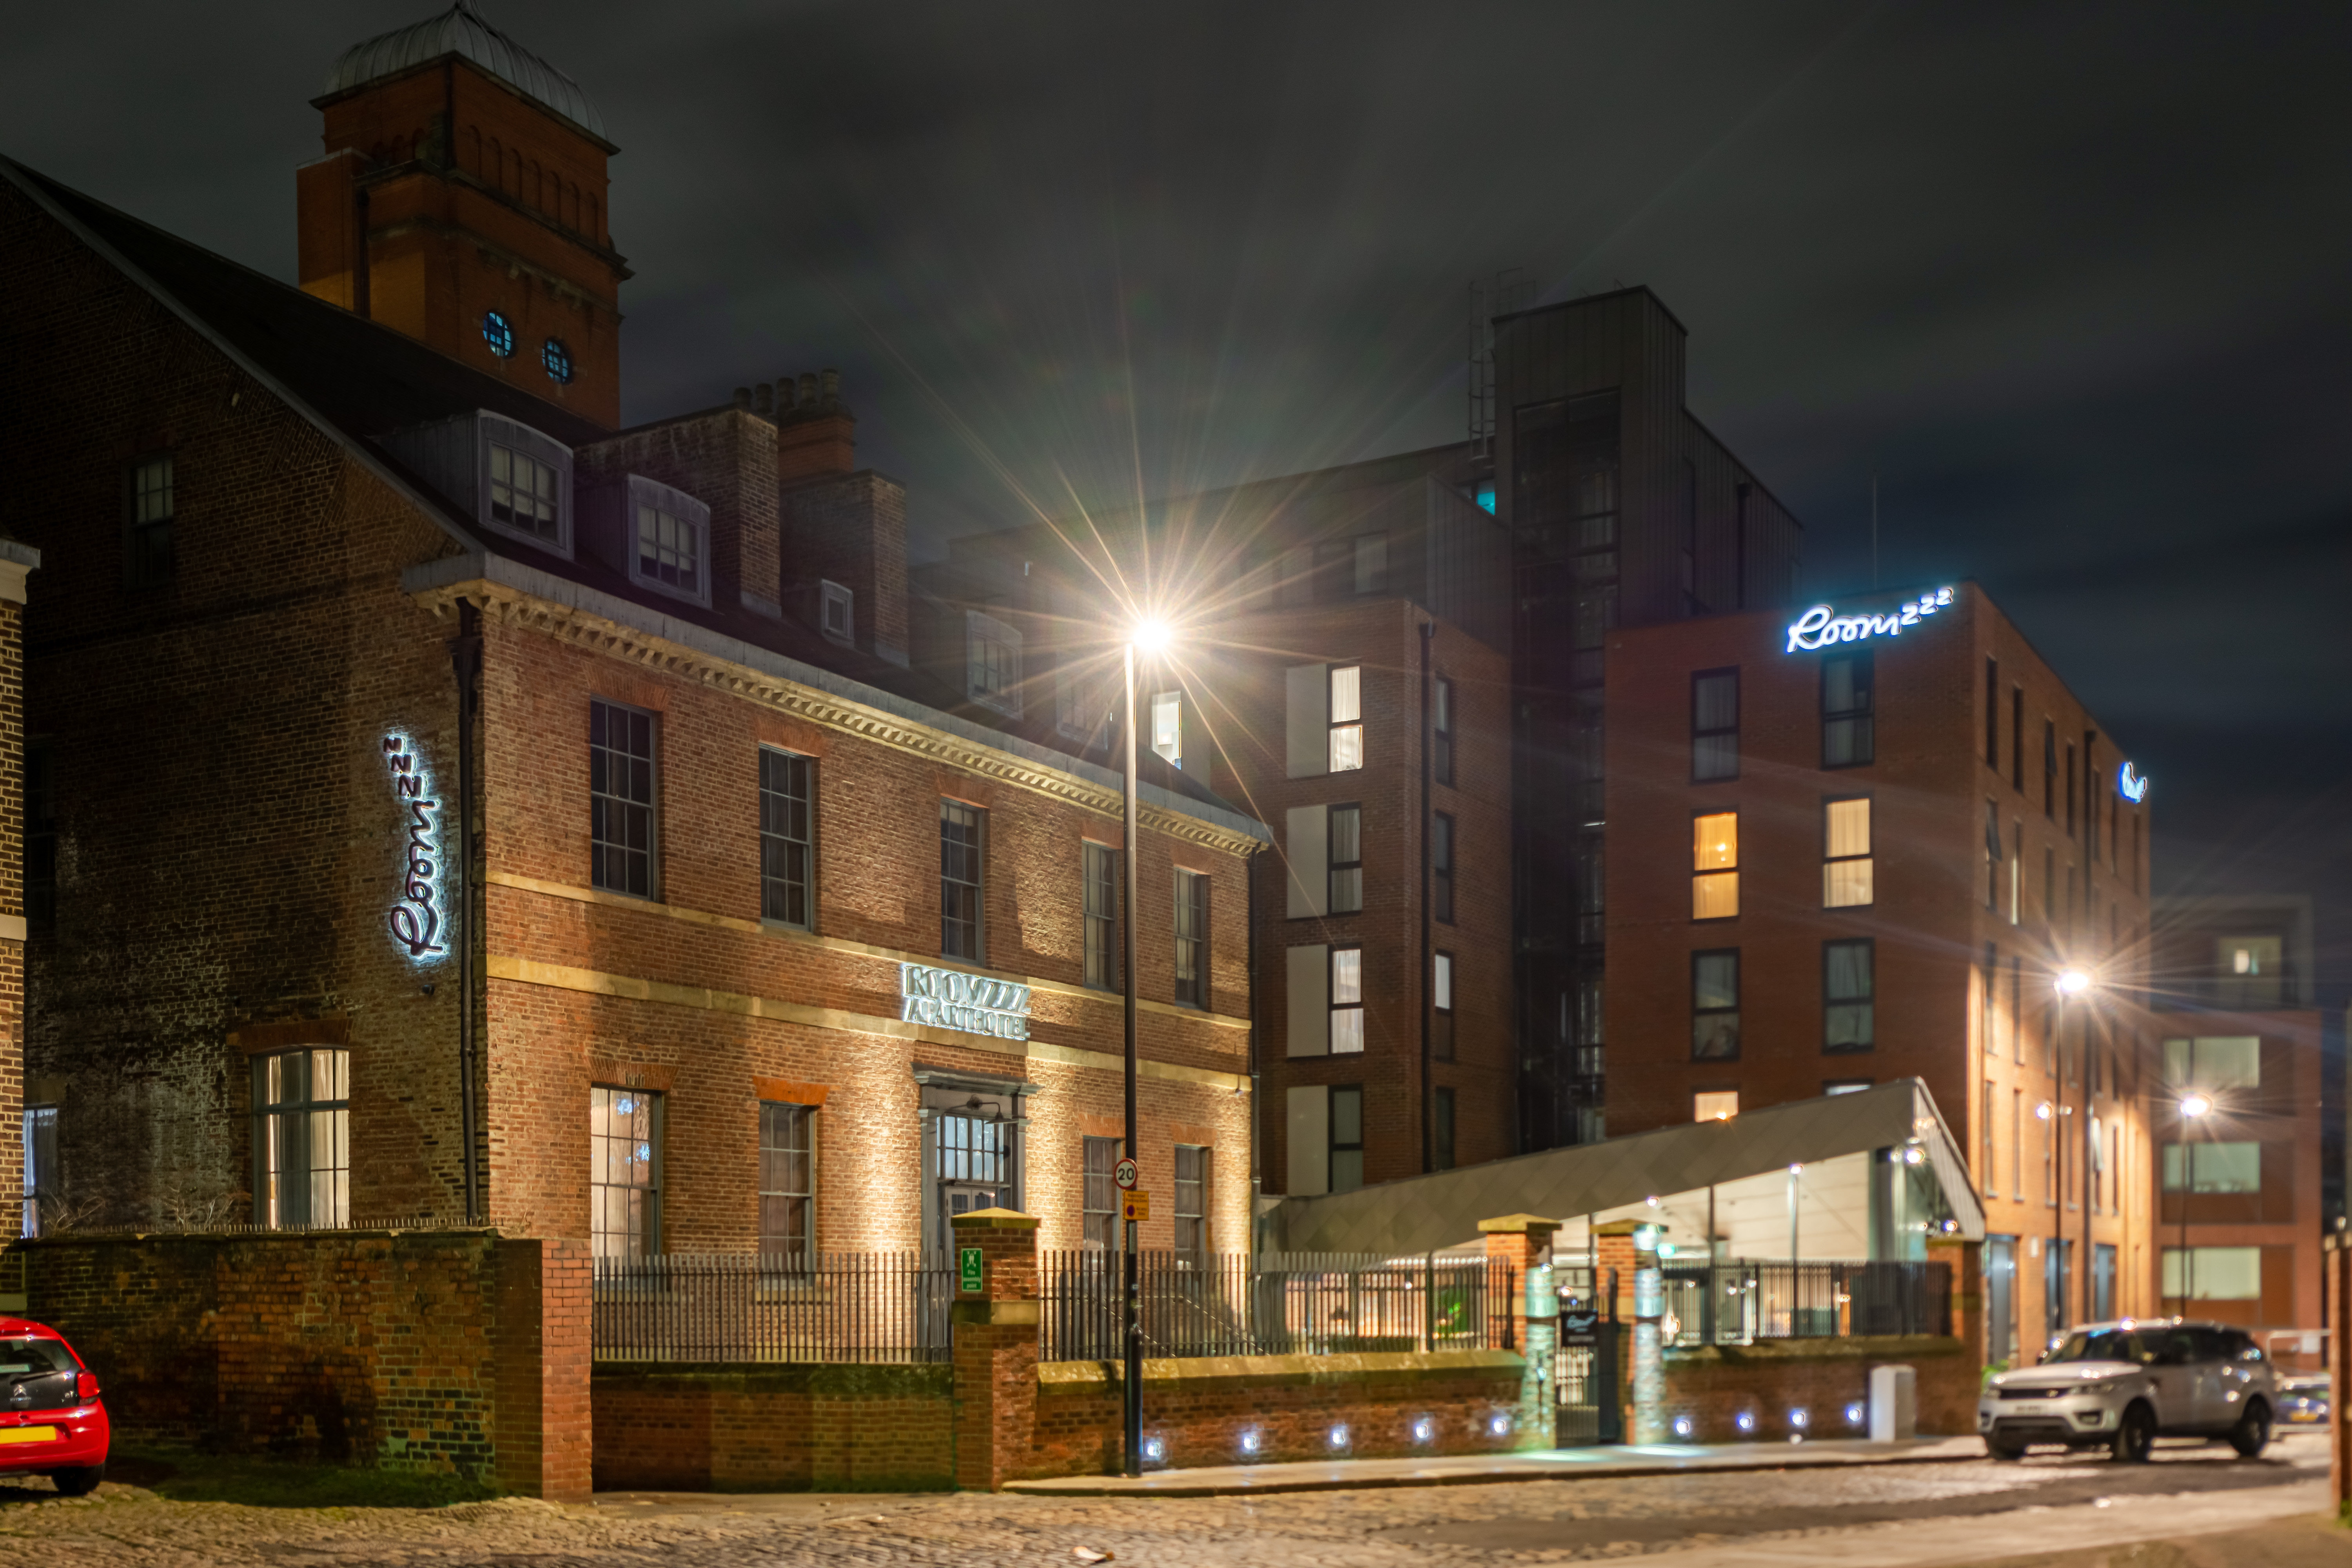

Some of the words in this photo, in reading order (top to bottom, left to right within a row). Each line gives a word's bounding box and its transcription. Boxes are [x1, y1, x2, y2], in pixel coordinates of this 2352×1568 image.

[1787, 588, 1953, 653] Roomzzz
[383, 737, 443, 956] Roomzzz
[1118, 1168, 1134, 1180] 20
